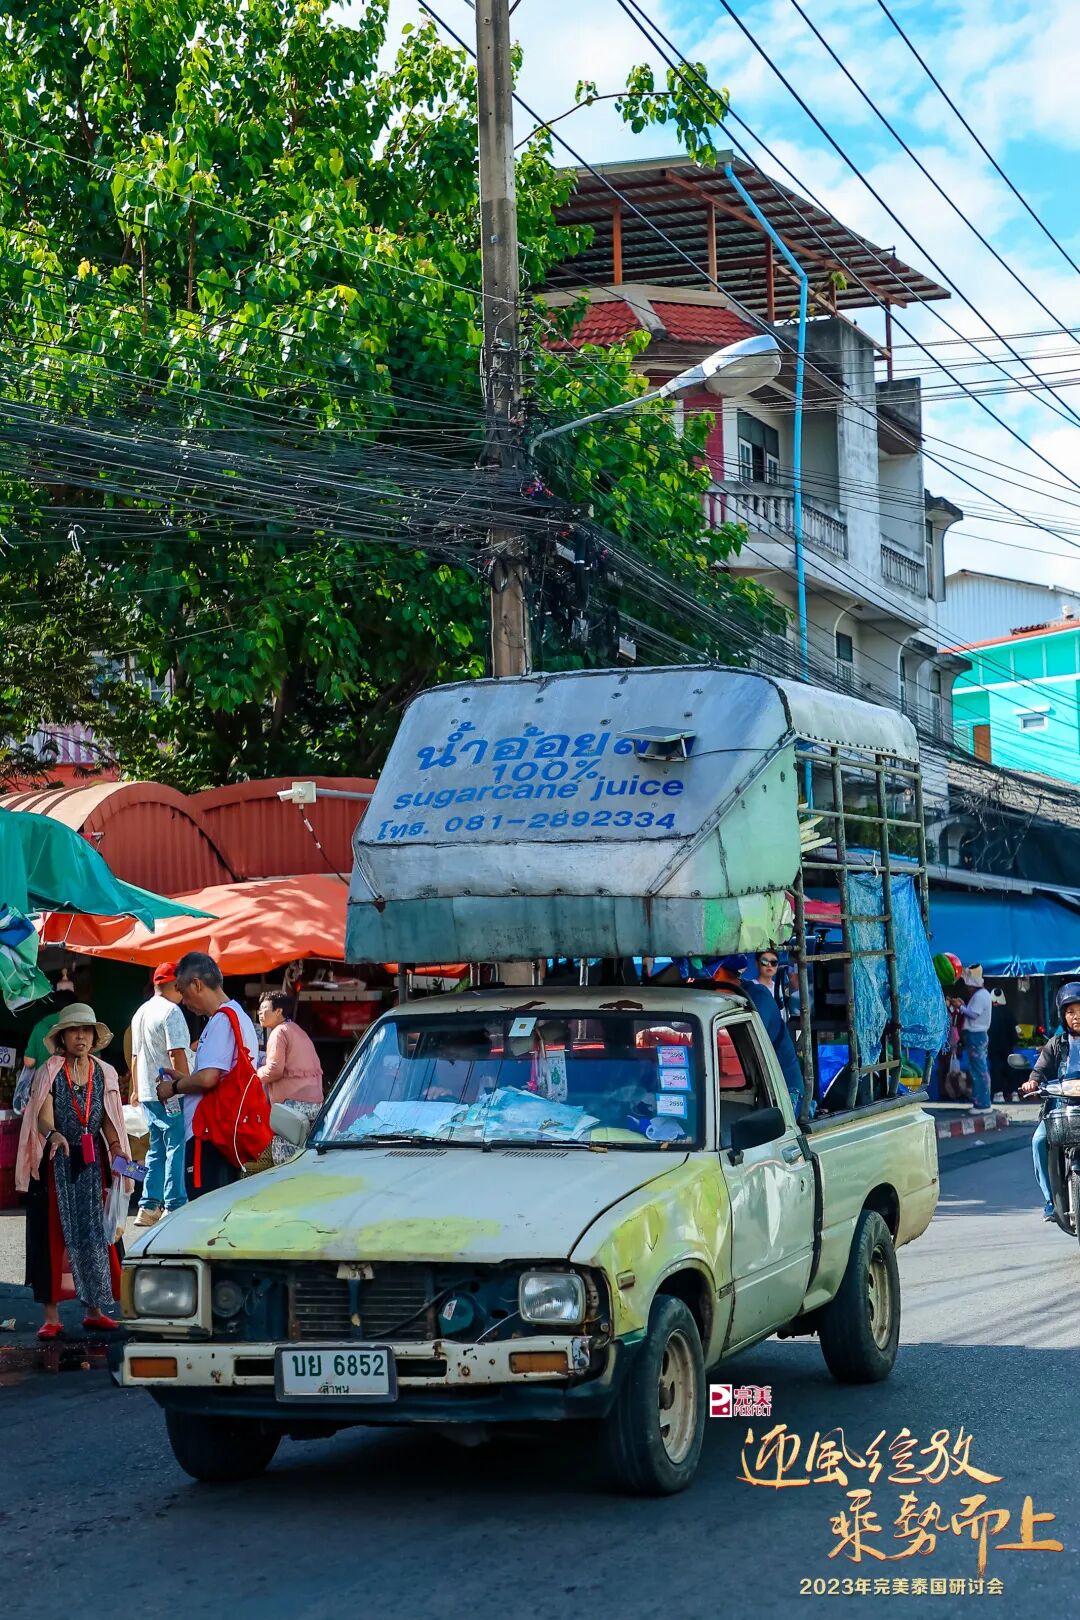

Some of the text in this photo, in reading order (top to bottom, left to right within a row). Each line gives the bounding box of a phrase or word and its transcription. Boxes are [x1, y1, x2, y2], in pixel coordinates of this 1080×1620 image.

[492, 758, 602, 784] 100%
[393, 775, 684, 810] sugarcane juice
[444, 810, 676, 833] 081-2892334
[292, 1354, 385, 1377] บย 6852
